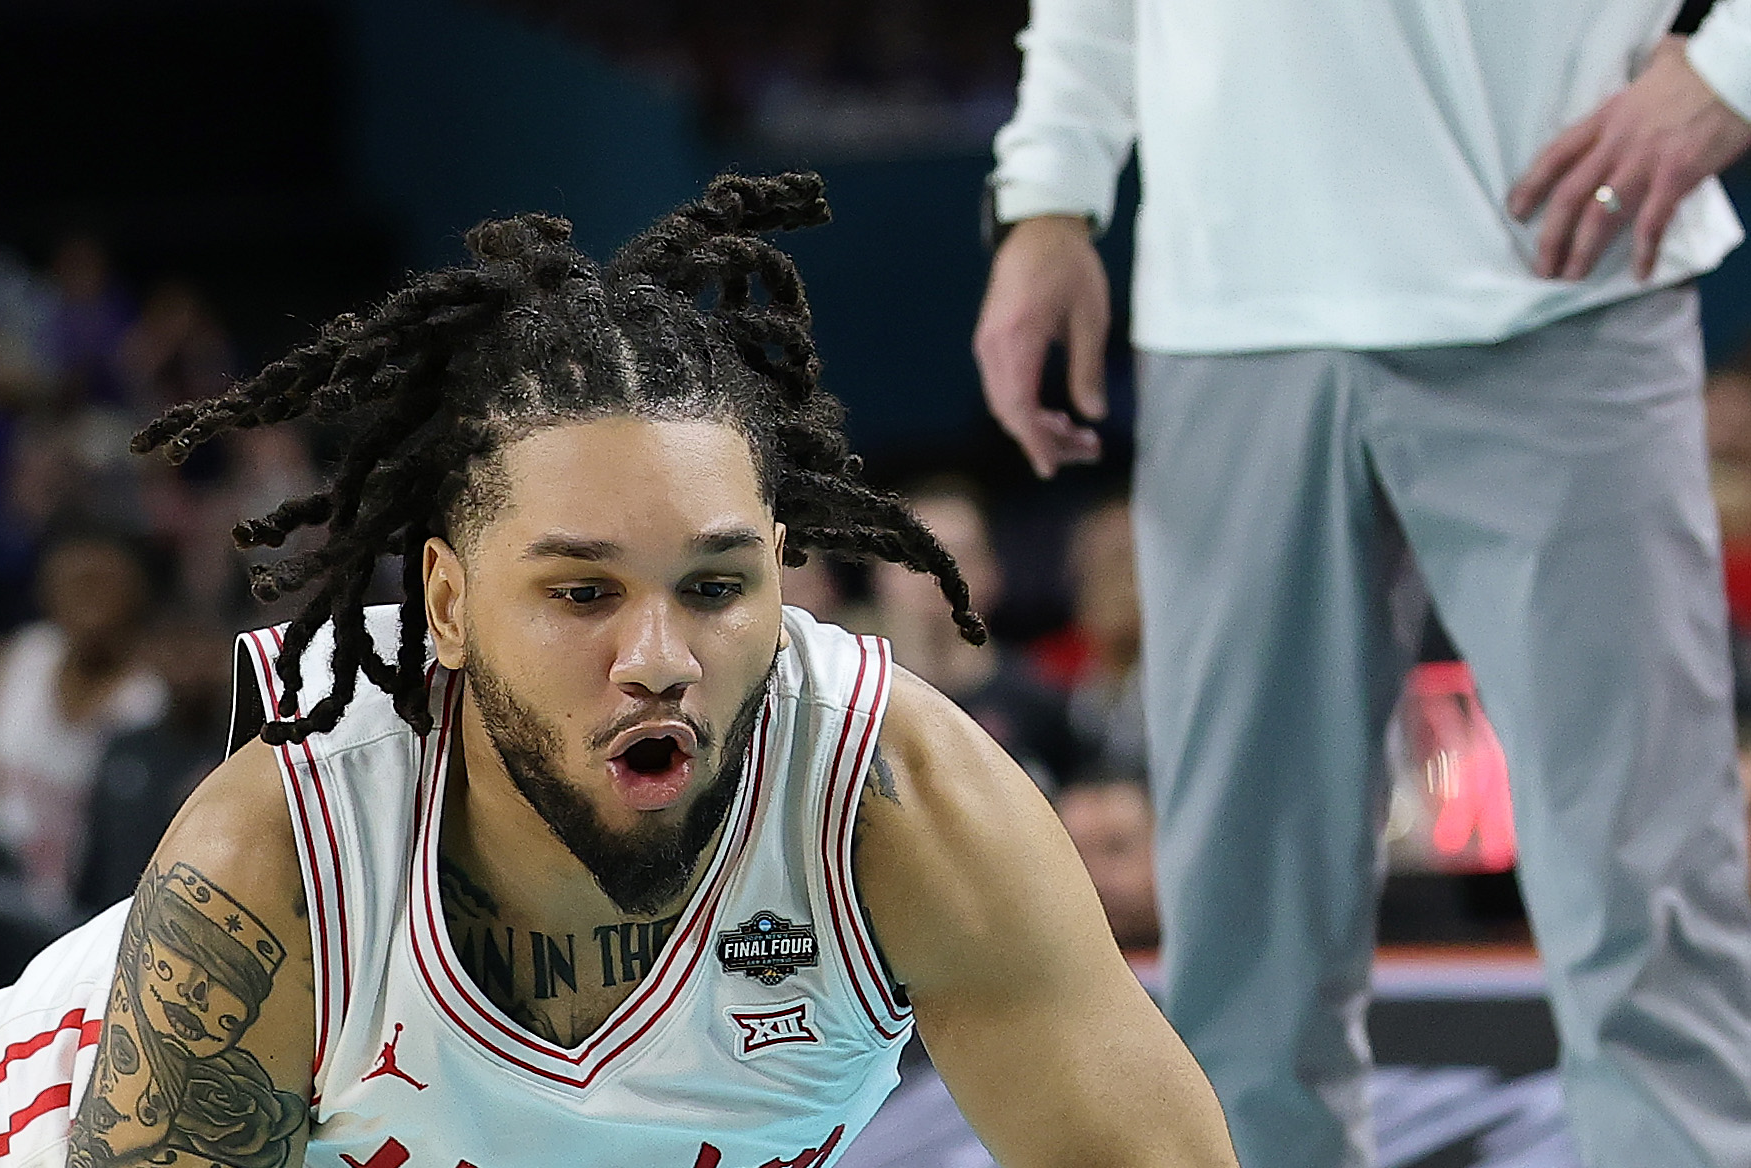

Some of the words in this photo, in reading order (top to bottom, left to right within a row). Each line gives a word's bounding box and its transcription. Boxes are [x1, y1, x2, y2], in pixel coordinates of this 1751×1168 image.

[529, 931, 578, 1000] IN
[724, 940, 769, 960] FINAL
[771, 937, 813, 956] FOUR
